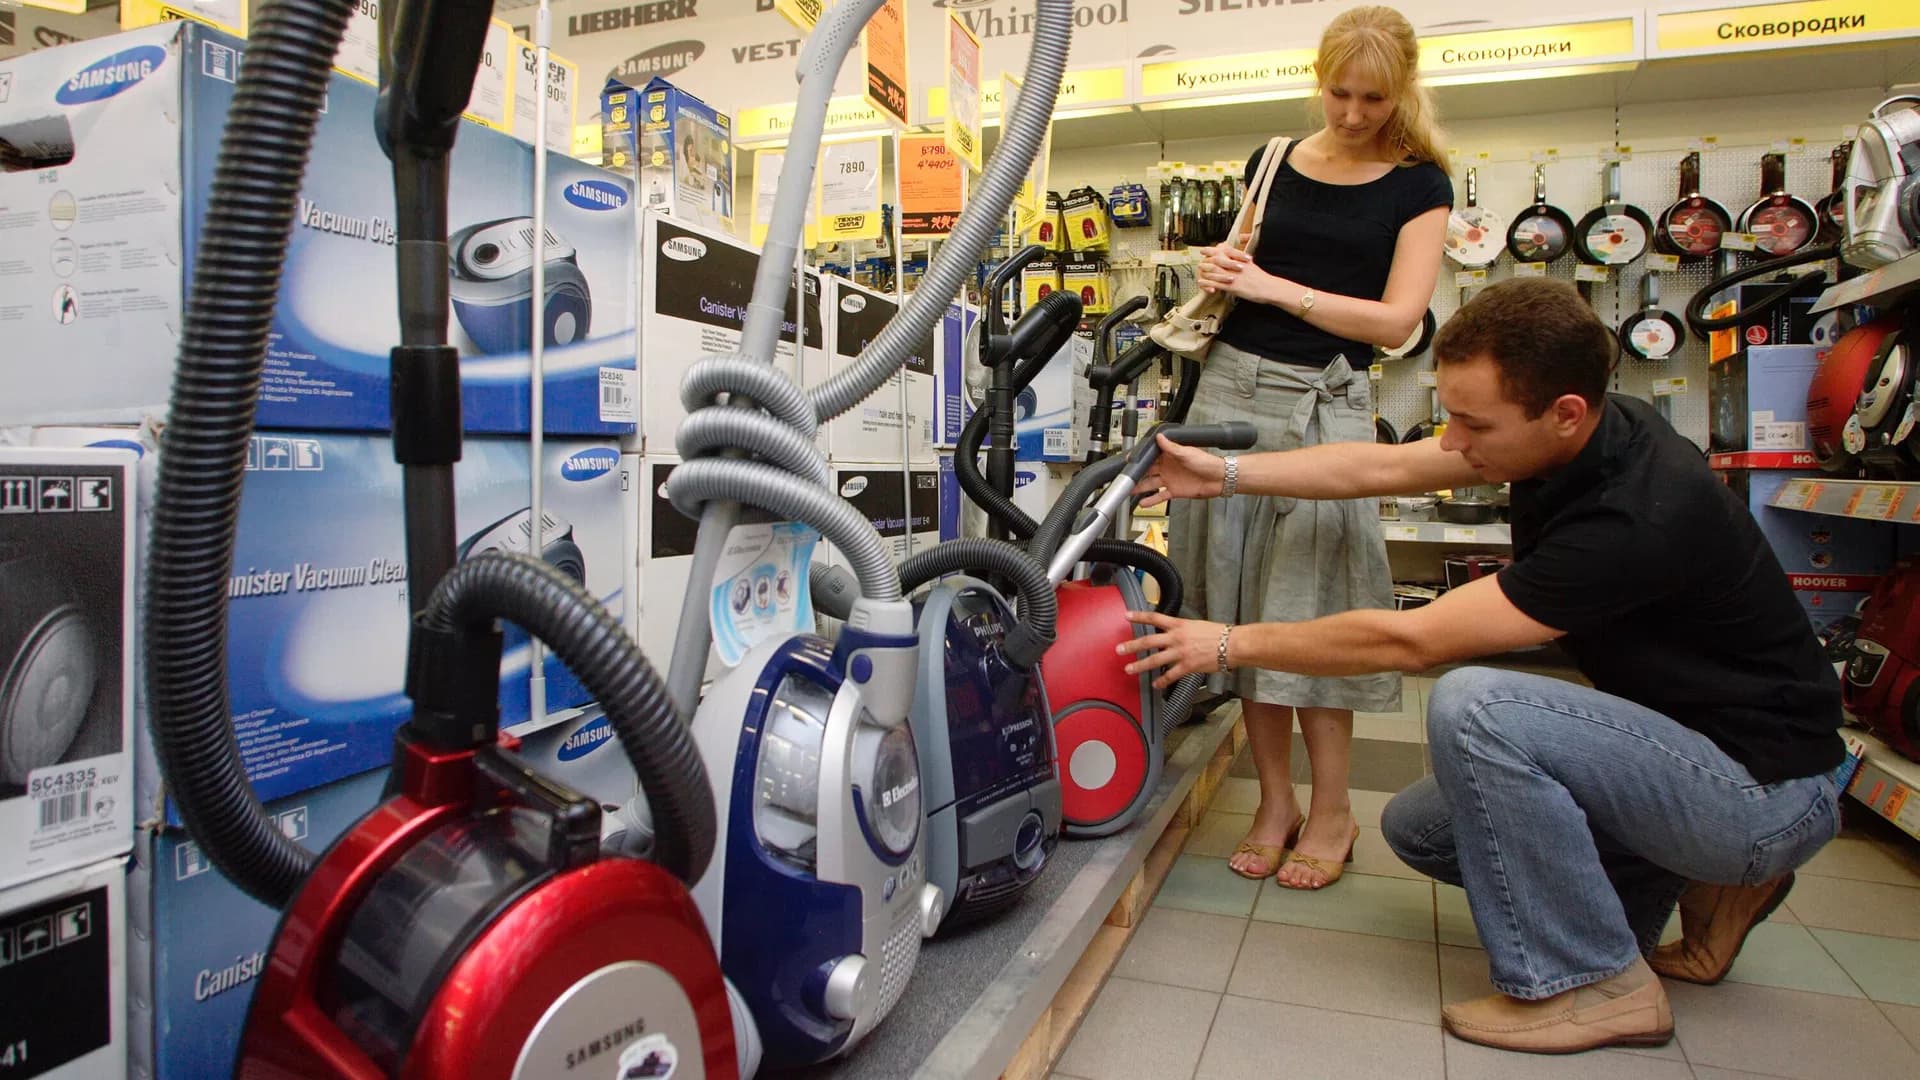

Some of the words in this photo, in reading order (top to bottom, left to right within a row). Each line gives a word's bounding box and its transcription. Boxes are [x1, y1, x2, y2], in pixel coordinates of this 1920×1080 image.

[568, 0, 697, 37] LIEBHERR
[1717, 14, 1866, 40] Сковородки
[616, 51, 695, 76] SAMSUNG
[1442, 40, 1572, 64] Сковородки
[68, 60, 152, 92] SAMSUNG
[1177, 70, 1269, 89] Кухонные
[1277, 63, 1314, 77] нож
[840, 161, 865, 174] 7890
[572, 183, 623, 208] SAMSUNG
[1062, 195, 1090, 207] TECHNO
[301, 198, 367, 239] Vacuum
[667, 239, 702, 257] SAMSUNG
[700, 296, 736, 319] Canister
[566, 457, 615, 471] SAMSUNG
[229, 567, 291, 598] nister
[294, 562, 366, 592] Vacuum
[369, 557, 408, 584] Clea
[1793, 577, 1847, 588] HOOVER
[973, 621, 1004, 639] PHILIPS
[31, 767, 97, 793] SC4335
[565, 1017, 645, 1070] SAMSUNG
